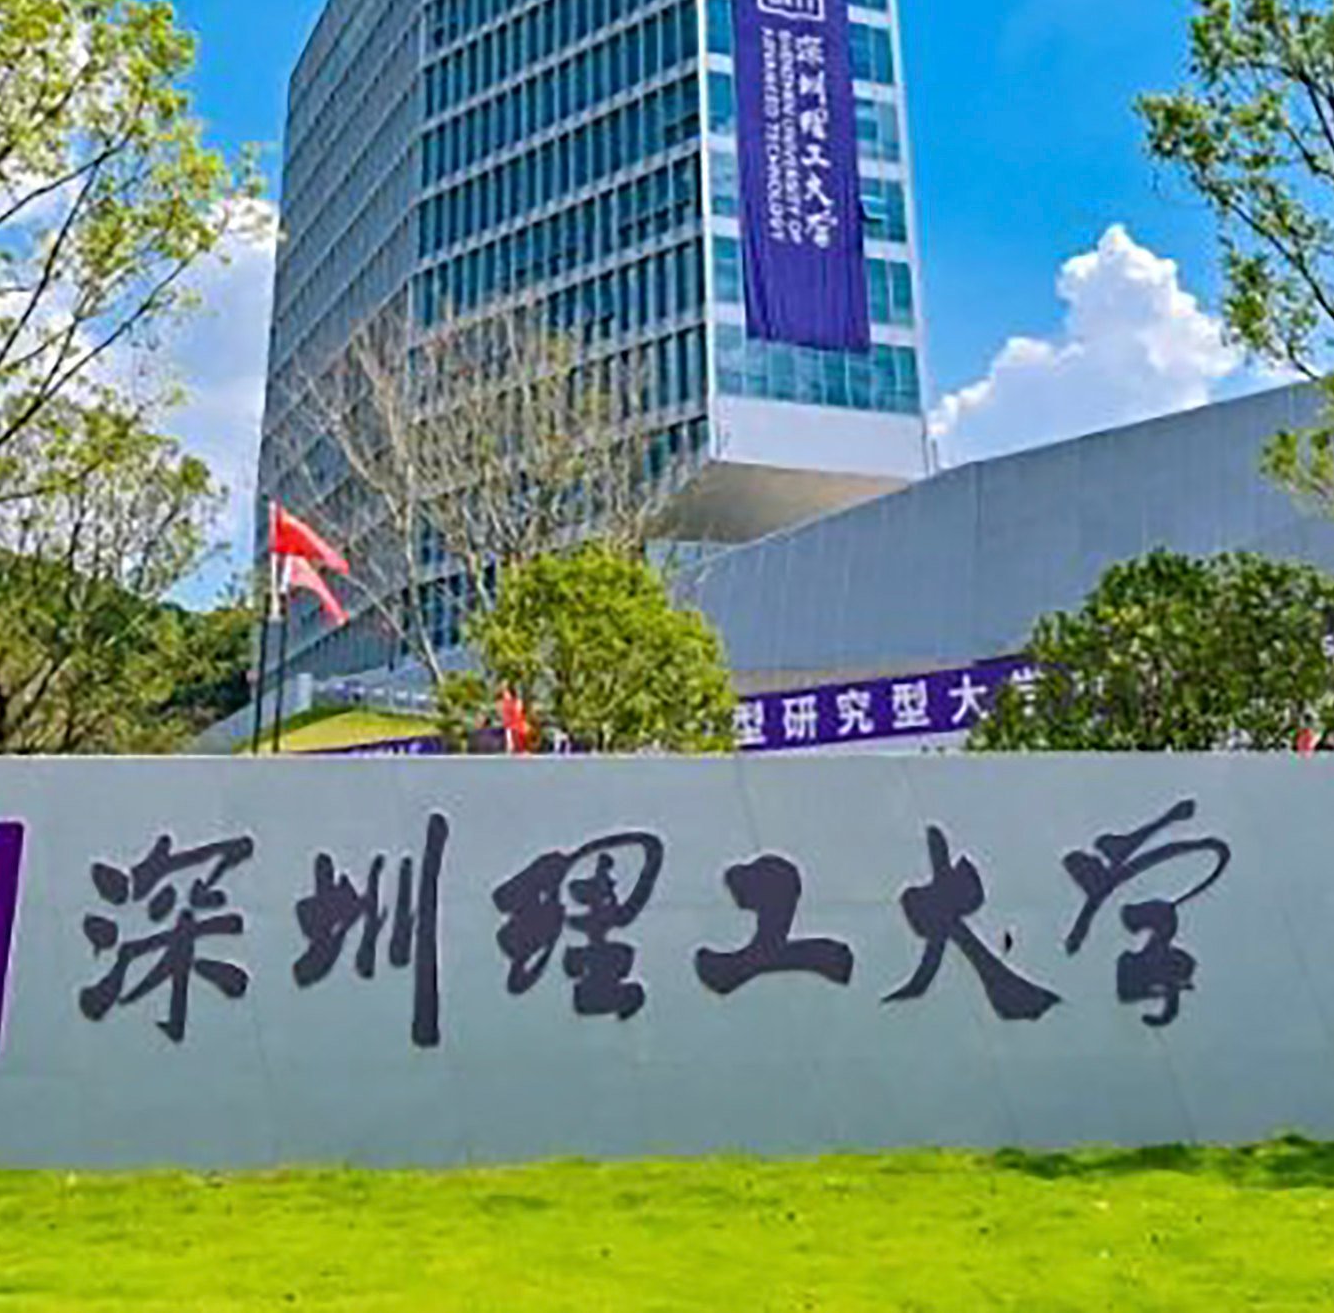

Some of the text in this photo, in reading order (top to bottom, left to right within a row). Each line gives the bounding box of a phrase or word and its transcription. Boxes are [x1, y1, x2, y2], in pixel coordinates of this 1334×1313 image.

[766, 122, 784, 240] TECHNOLOGY
[782, 119, 800, 215] UNIVERSITY
[795, 34, 838, 248] 深圳理工大学
[788, 219, 802, 243] OF
[79, 800, 1230, 1048] 深圳理工大学
